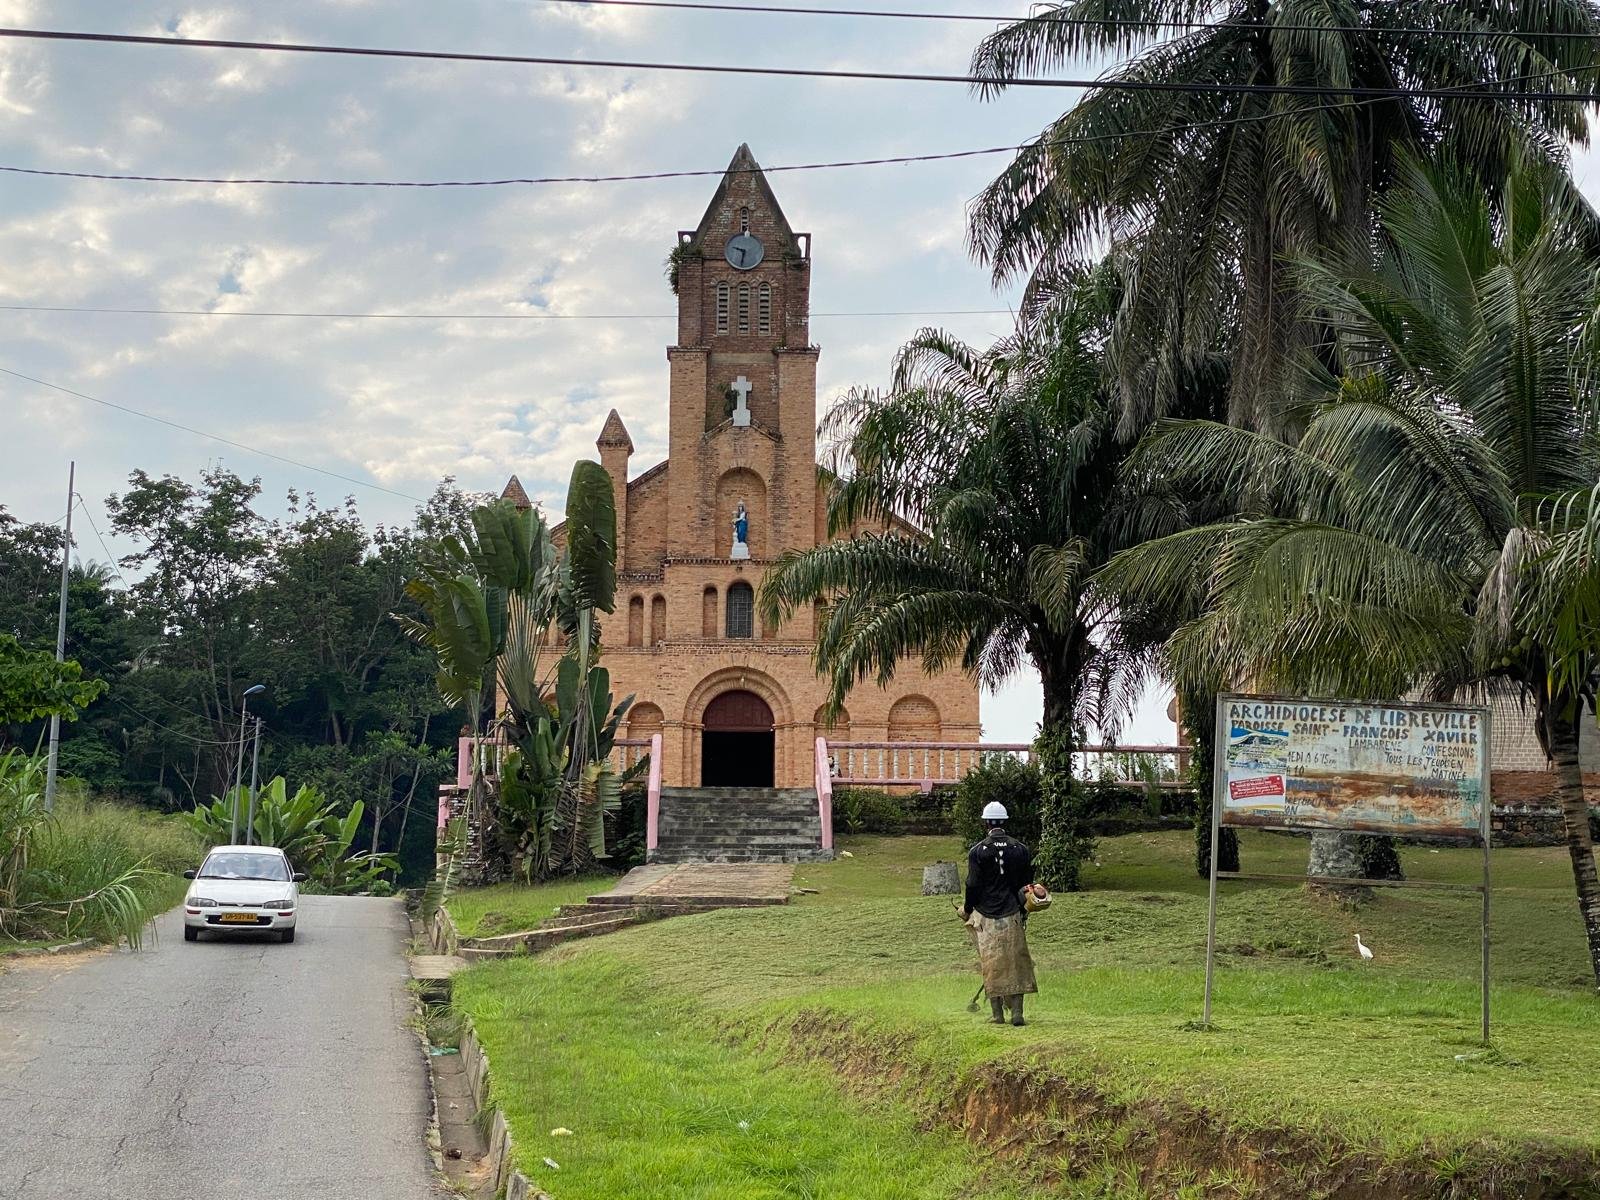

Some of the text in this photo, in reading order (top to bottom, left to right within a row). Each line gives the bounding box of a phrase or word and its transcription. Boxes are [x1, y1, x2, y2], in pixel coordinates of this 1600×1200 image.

[1230, 704, 1477, 729] ARCHIDIOCESE DE LIBREVILLE
[1423, 729, 1478, 744] XAVIER
[1421, 744, 1475, 758] CONFESSIONS
[1385, 751, 1402, 764] TOUS
[1407, 754, 1422, 767] LES
